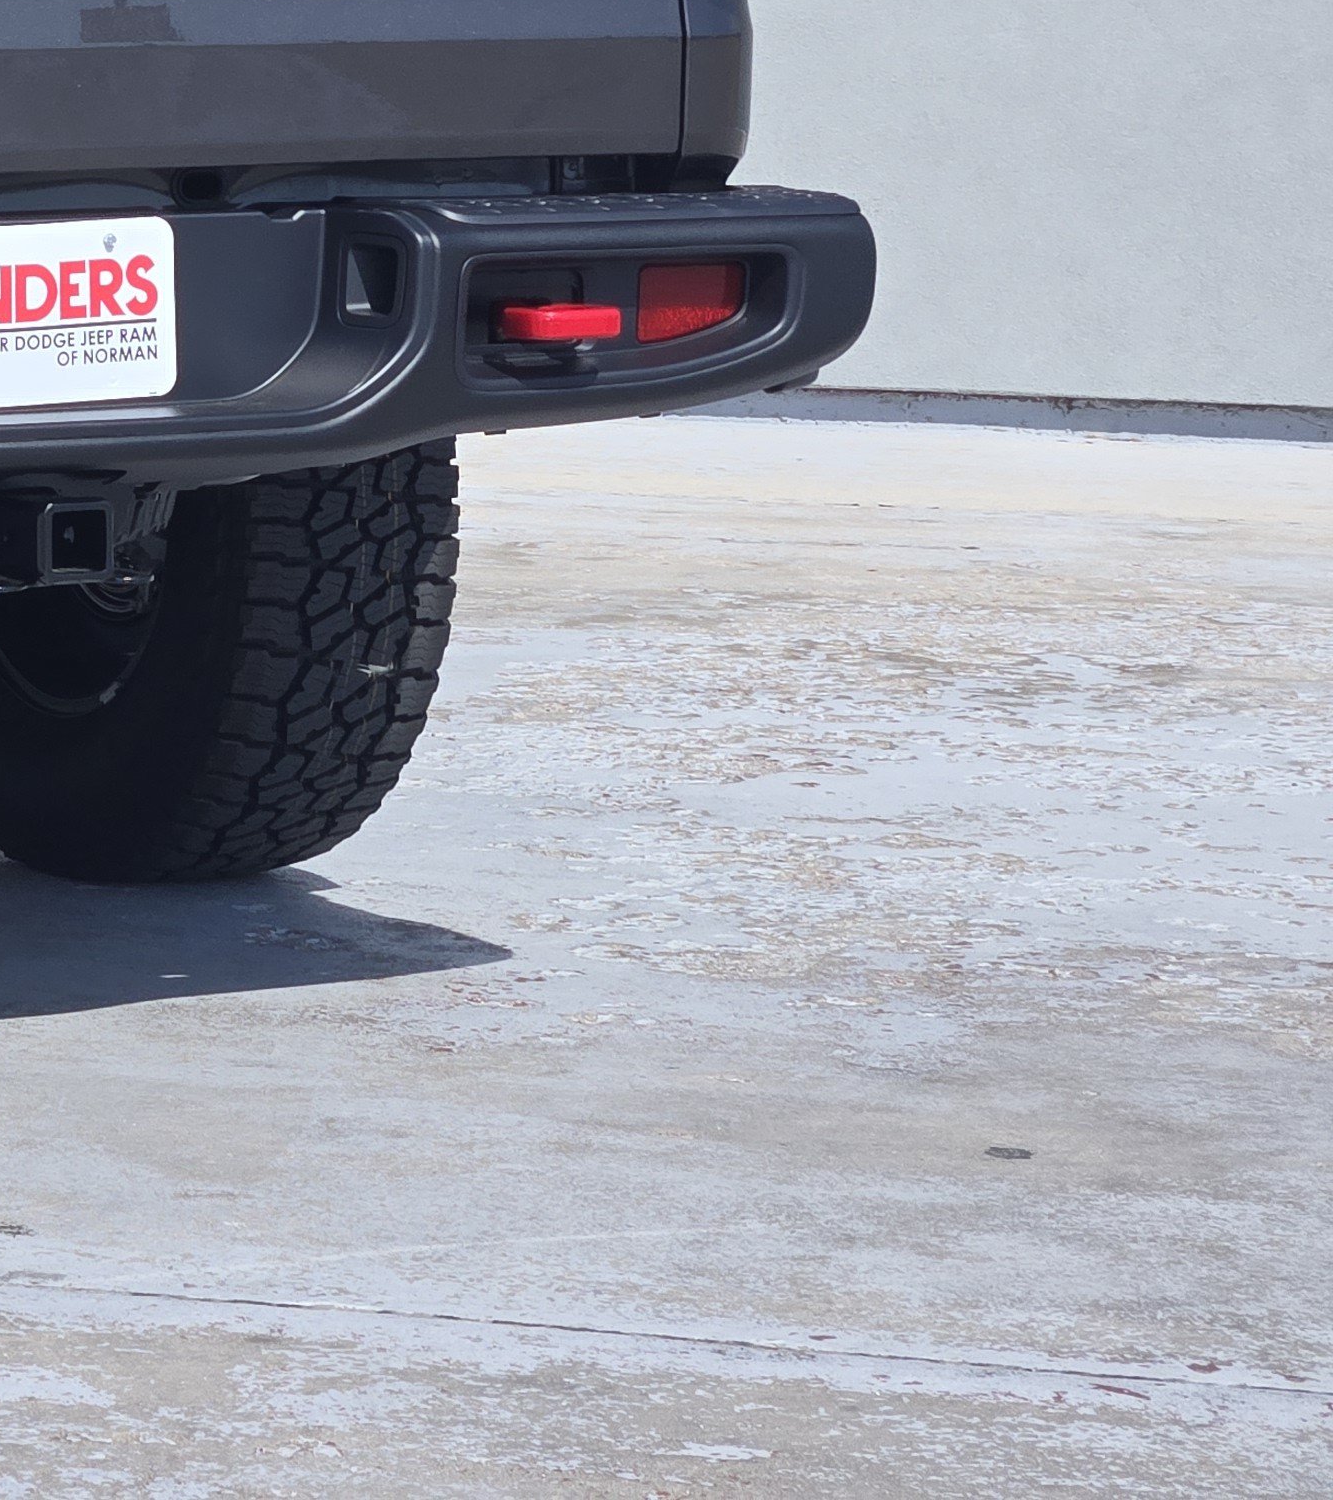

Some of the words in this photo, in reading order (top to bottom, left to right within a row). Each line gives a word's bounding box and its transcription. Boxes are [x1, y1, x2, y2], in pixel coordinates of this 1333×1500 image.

[15, 332, 75, 351] DODGE
[80, 330, 114, 348] JEEP
[119, 326, 157, 344] RAM
[57, 351, 78, 367] OF
[84, 344, 159, 365] NORMAN
